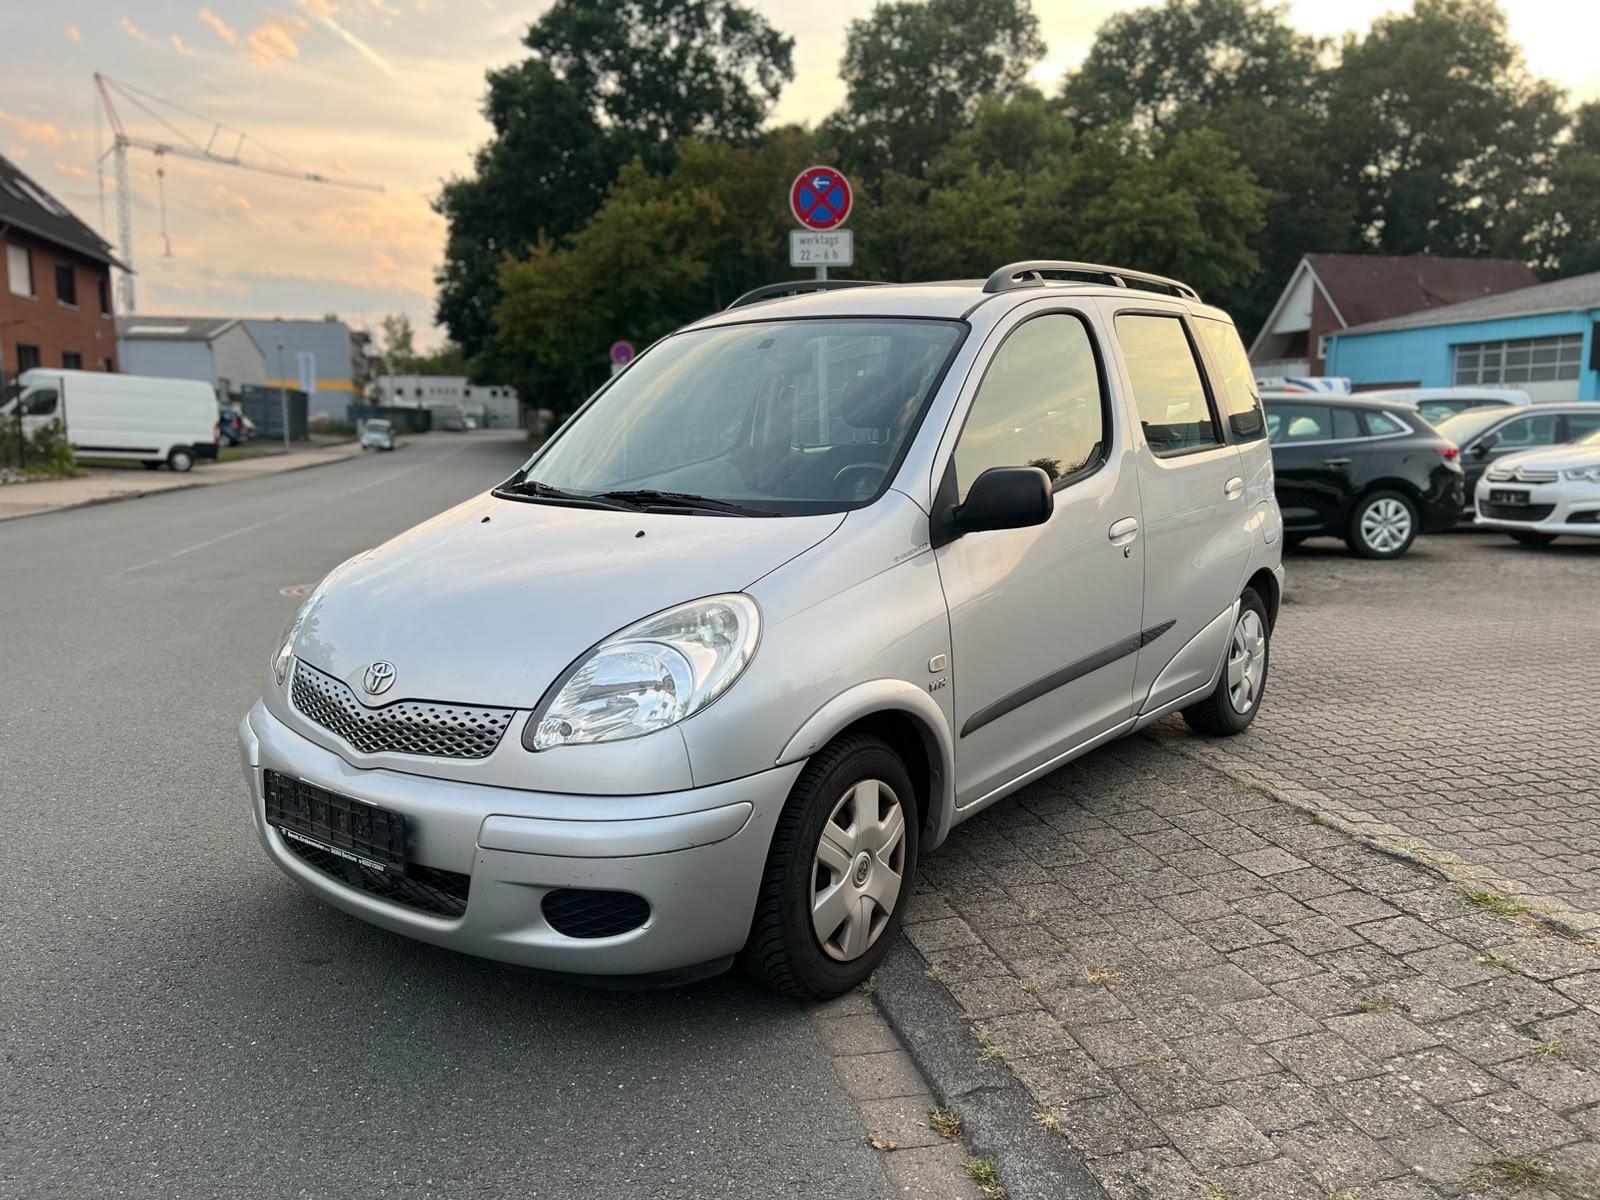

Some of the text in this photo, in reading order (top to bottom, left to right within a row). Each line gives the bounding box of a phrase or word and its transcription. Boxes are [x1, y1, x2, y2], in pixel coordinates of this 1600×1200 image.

[799, 235, 839, 247] werktags
[800, 250, 811, 261] 22
[832, 249, 838, 260] h
